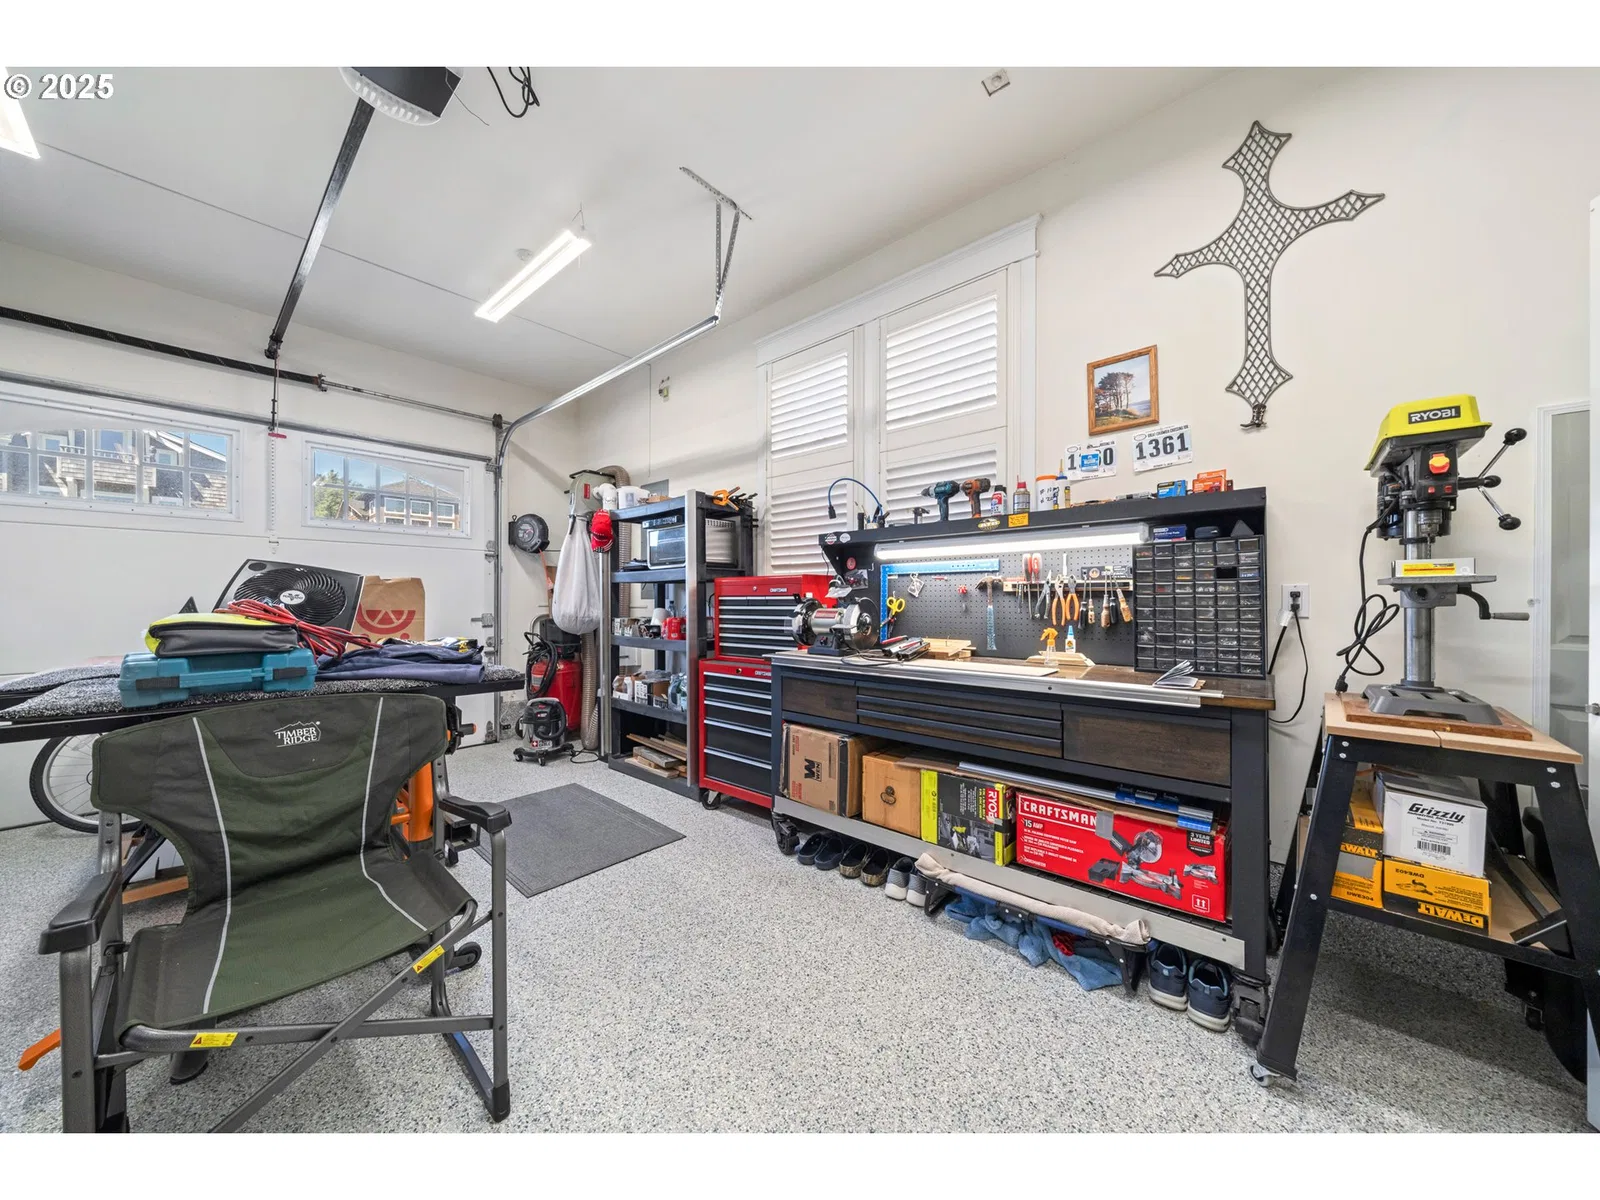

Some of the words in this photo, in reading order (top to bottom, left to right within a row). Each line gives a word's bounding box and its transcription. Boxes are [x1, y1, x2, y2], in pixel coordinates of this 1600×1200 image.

[1410, 408, 1456, 422] RYOBI
[1136, 432, 1189, 460] 1361
[1067, 447, 1114, 471] 10
[275, 726, 317, 739] TIMBER
[284, 733, 318, 745] RIDGE
[1023, 800, 1097, 826] CRAFTSMAN
[1408, 802, 1466, 823] Grizzly
[1025, 819, 1033, 828] 15
[1190, 837, 1210, 845] LIMITED
[1395, 868, 1425, 878] DWE402
